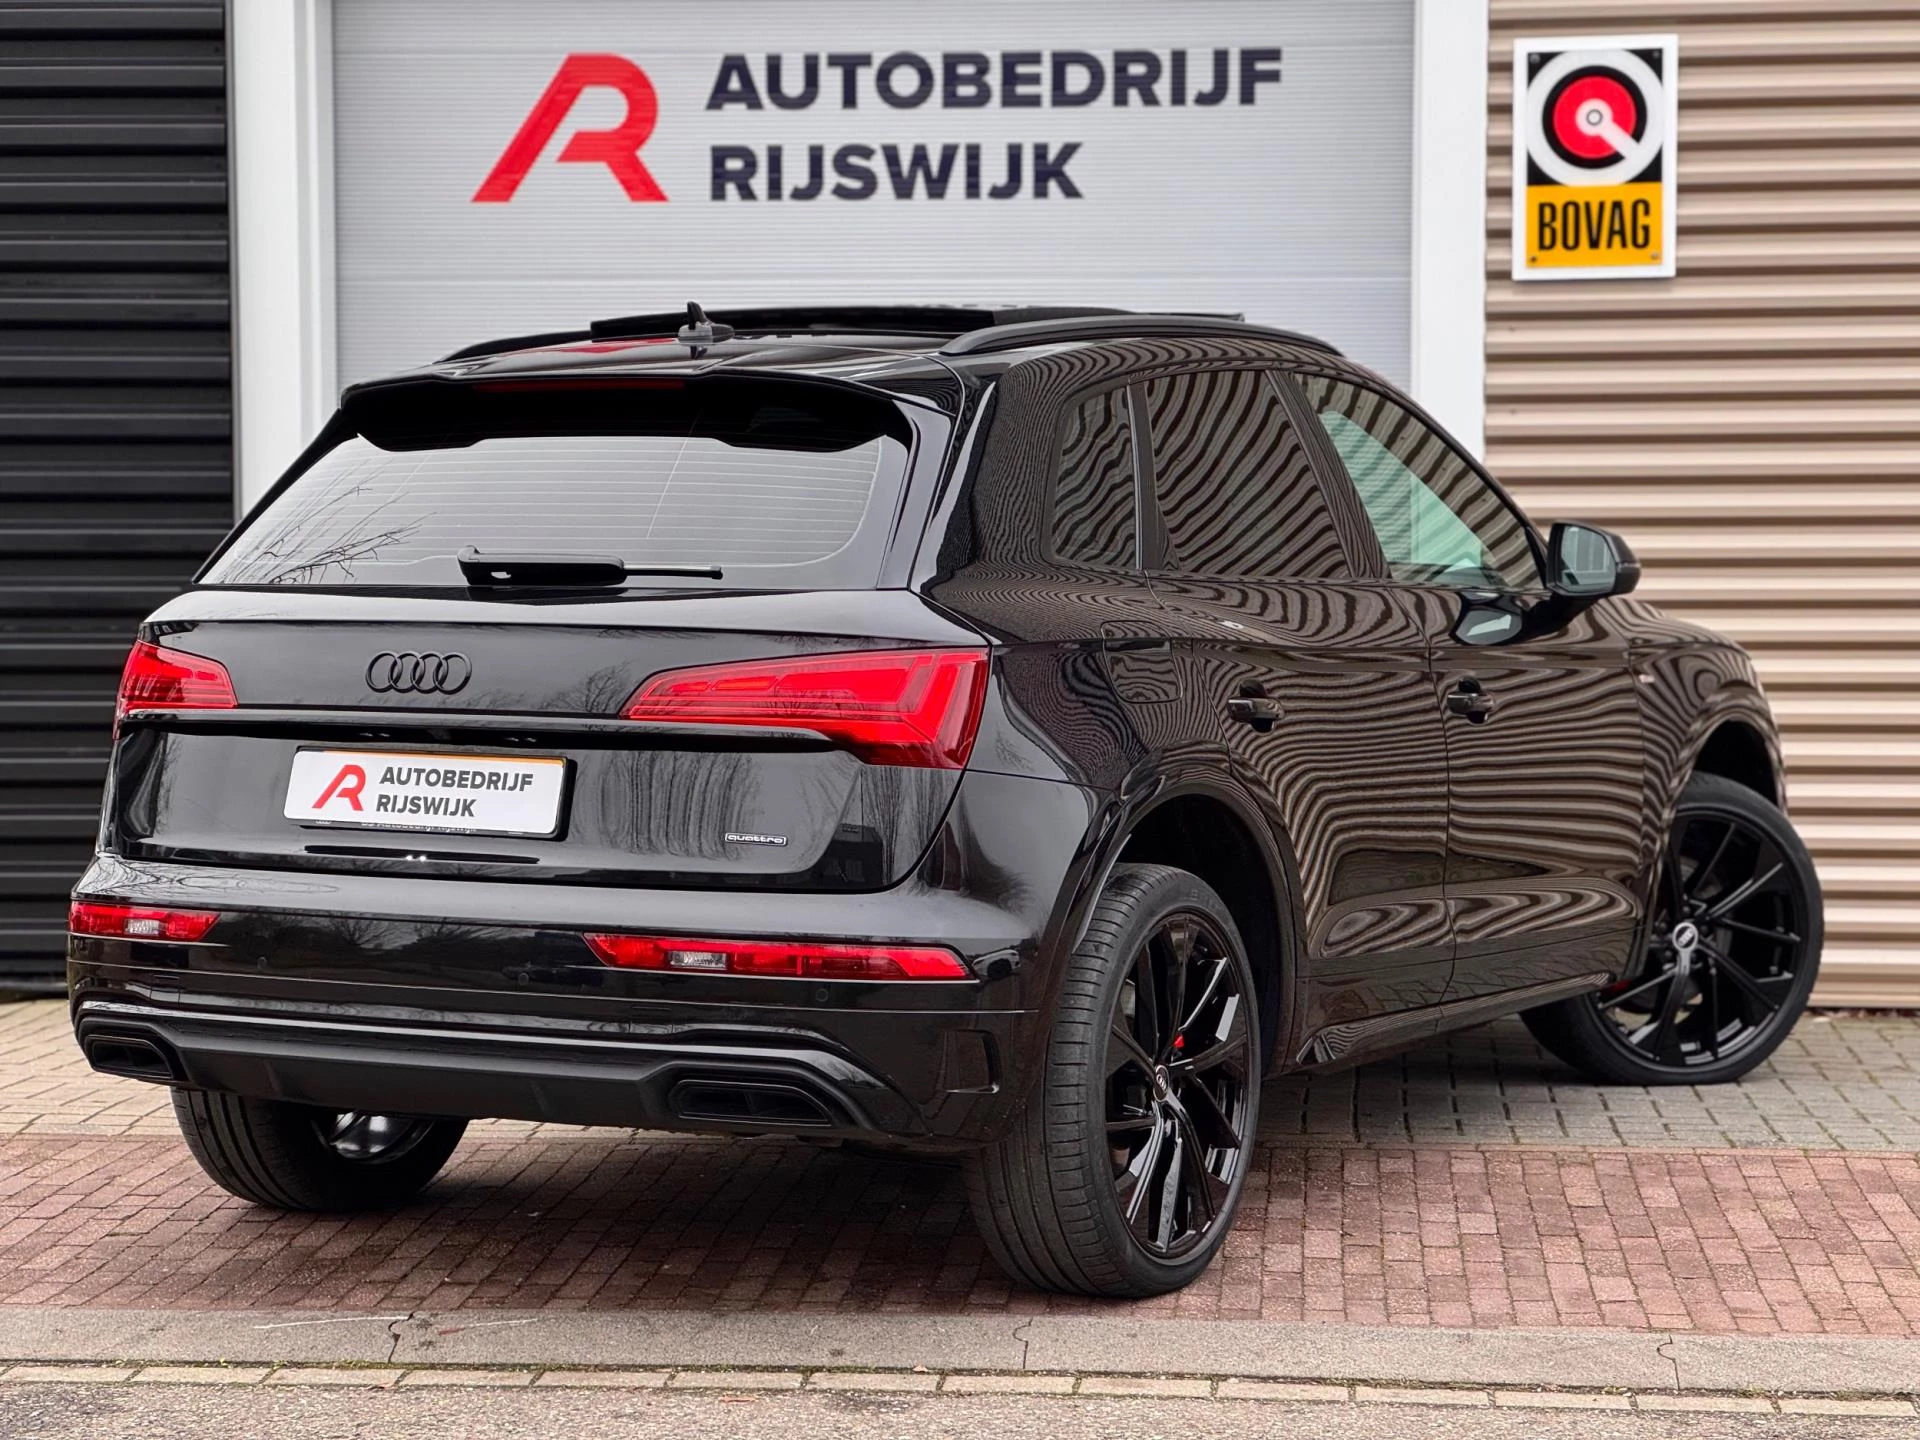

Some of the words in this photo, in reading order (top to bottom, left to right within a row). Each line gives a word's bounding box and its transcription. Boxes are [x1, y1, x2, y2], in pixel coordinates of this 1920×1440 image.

[706, 48, 1282, 110] AUTOBEDRIJF
[711, 143, 1082, 201] RIJSWIJK
[1539, 199, 1650, 250] BOVAG
[379, 766, 533, 792] AUTOBEDRIJF
[376, 794, 477, 817] RIJSWIJK
[727, 834, 784, 844] quattro
